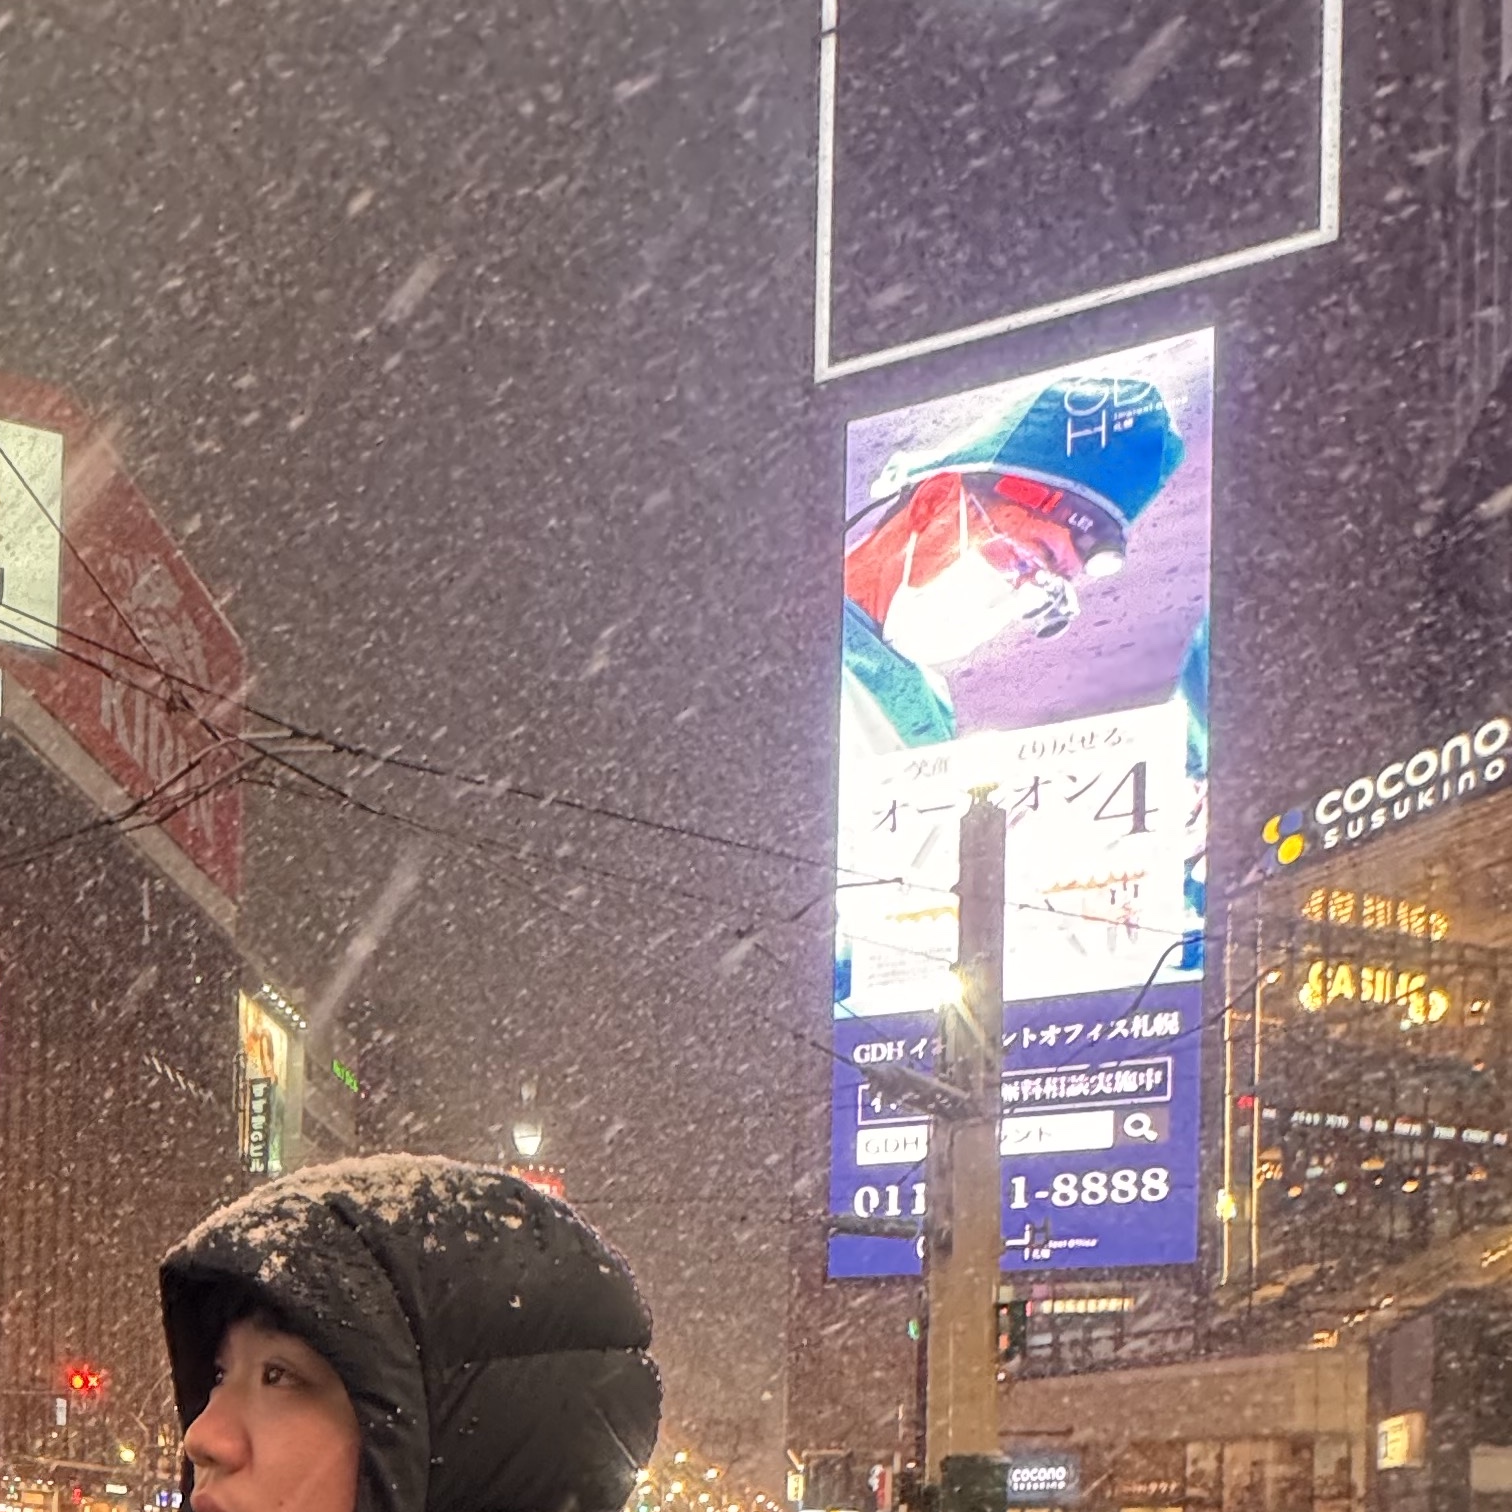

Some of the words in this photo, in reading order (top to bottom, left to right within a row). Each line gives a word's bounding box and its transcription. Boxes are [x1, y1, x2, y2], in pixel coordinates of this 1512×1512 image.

[873, 761, 1159, 836] オーオン4
[1323, 757, 1507, 850] SUSUKINO
[853, 1040, 906, 1064] GDH
[853, 1167, 1170, 1218] 0111-8888
